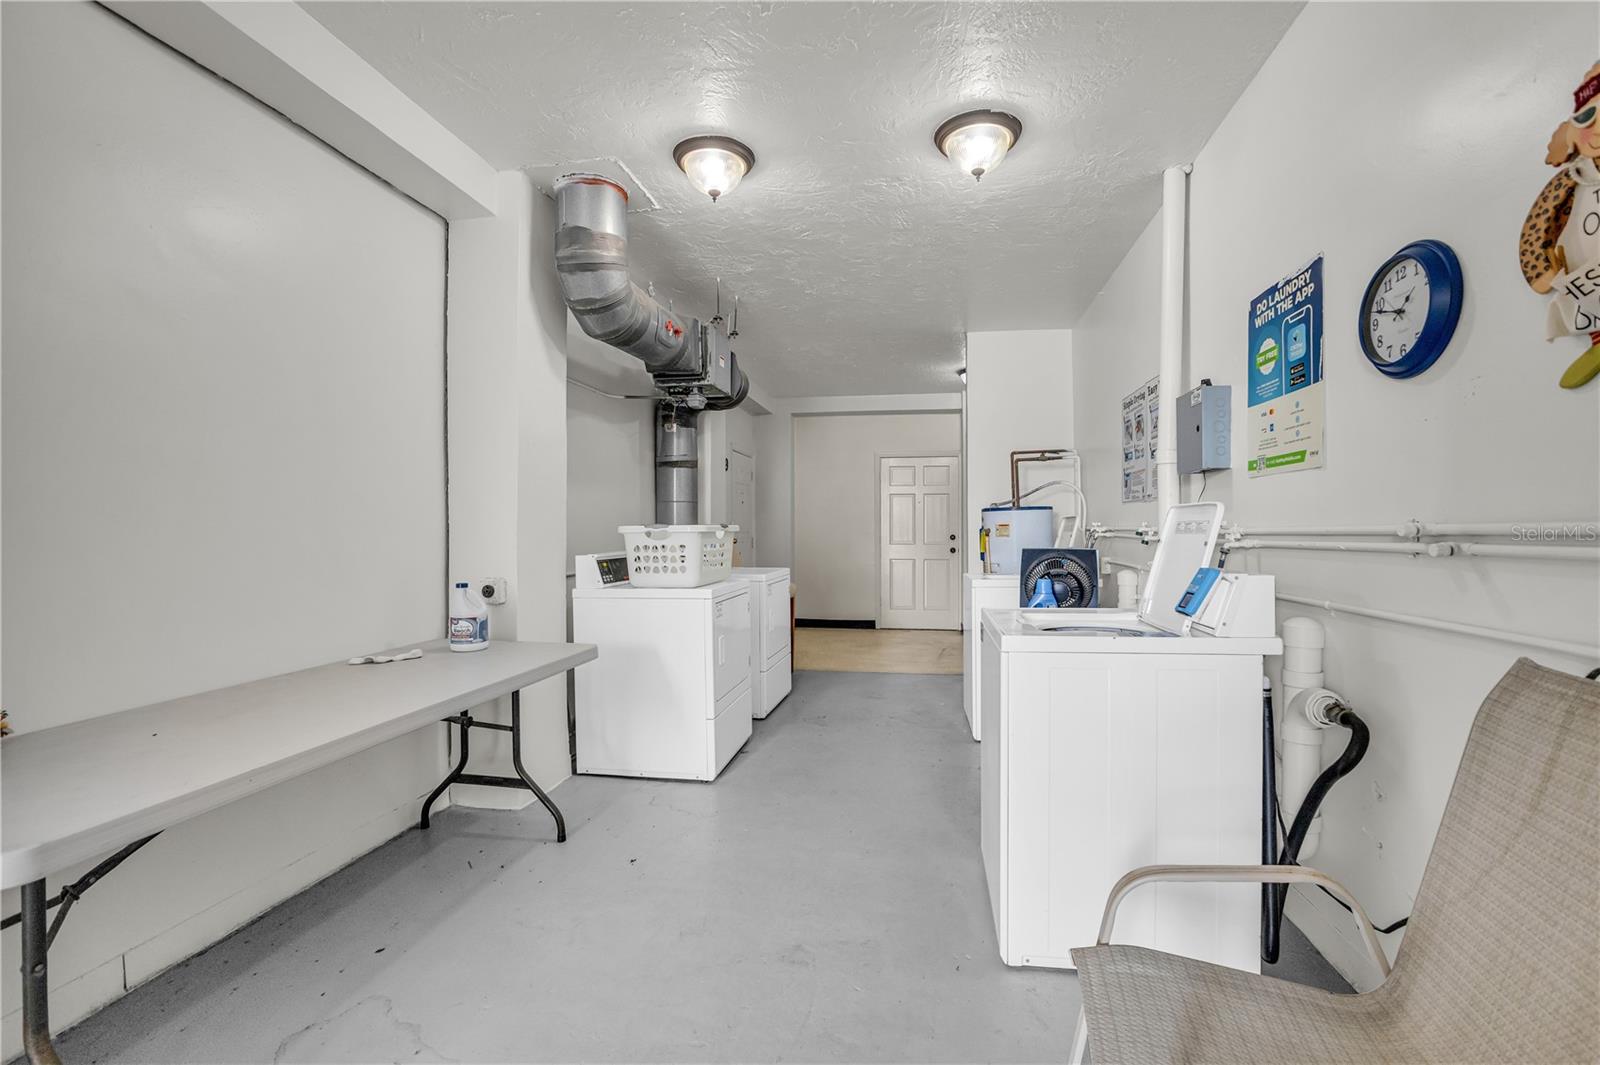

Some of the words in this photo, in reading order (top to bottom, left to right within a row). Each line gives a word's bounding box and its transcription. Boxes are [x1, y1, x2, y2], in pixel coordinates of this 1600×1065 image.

[1395, 265, 1407, 283] 12
[1414, 262, 1419, 277] 1
[1256, 299, 1268, 316] DO
[1268, 269, 1312, 307] LAUNDRY
[1384, 278, 1393, 294] 11
[1254, 307, 1275, 329] WITH
[1276, 295, 1294, 315] THE
[1294, 282, 1315, 305] APP
[1375, 297, 1385, 312] 10
[1372, 318, 1379, 332] 9
[1376, 335, 1384, 349] 8
[1386, 345, 1393, 359] 7
[1400, 343, 1407, 357] 6
